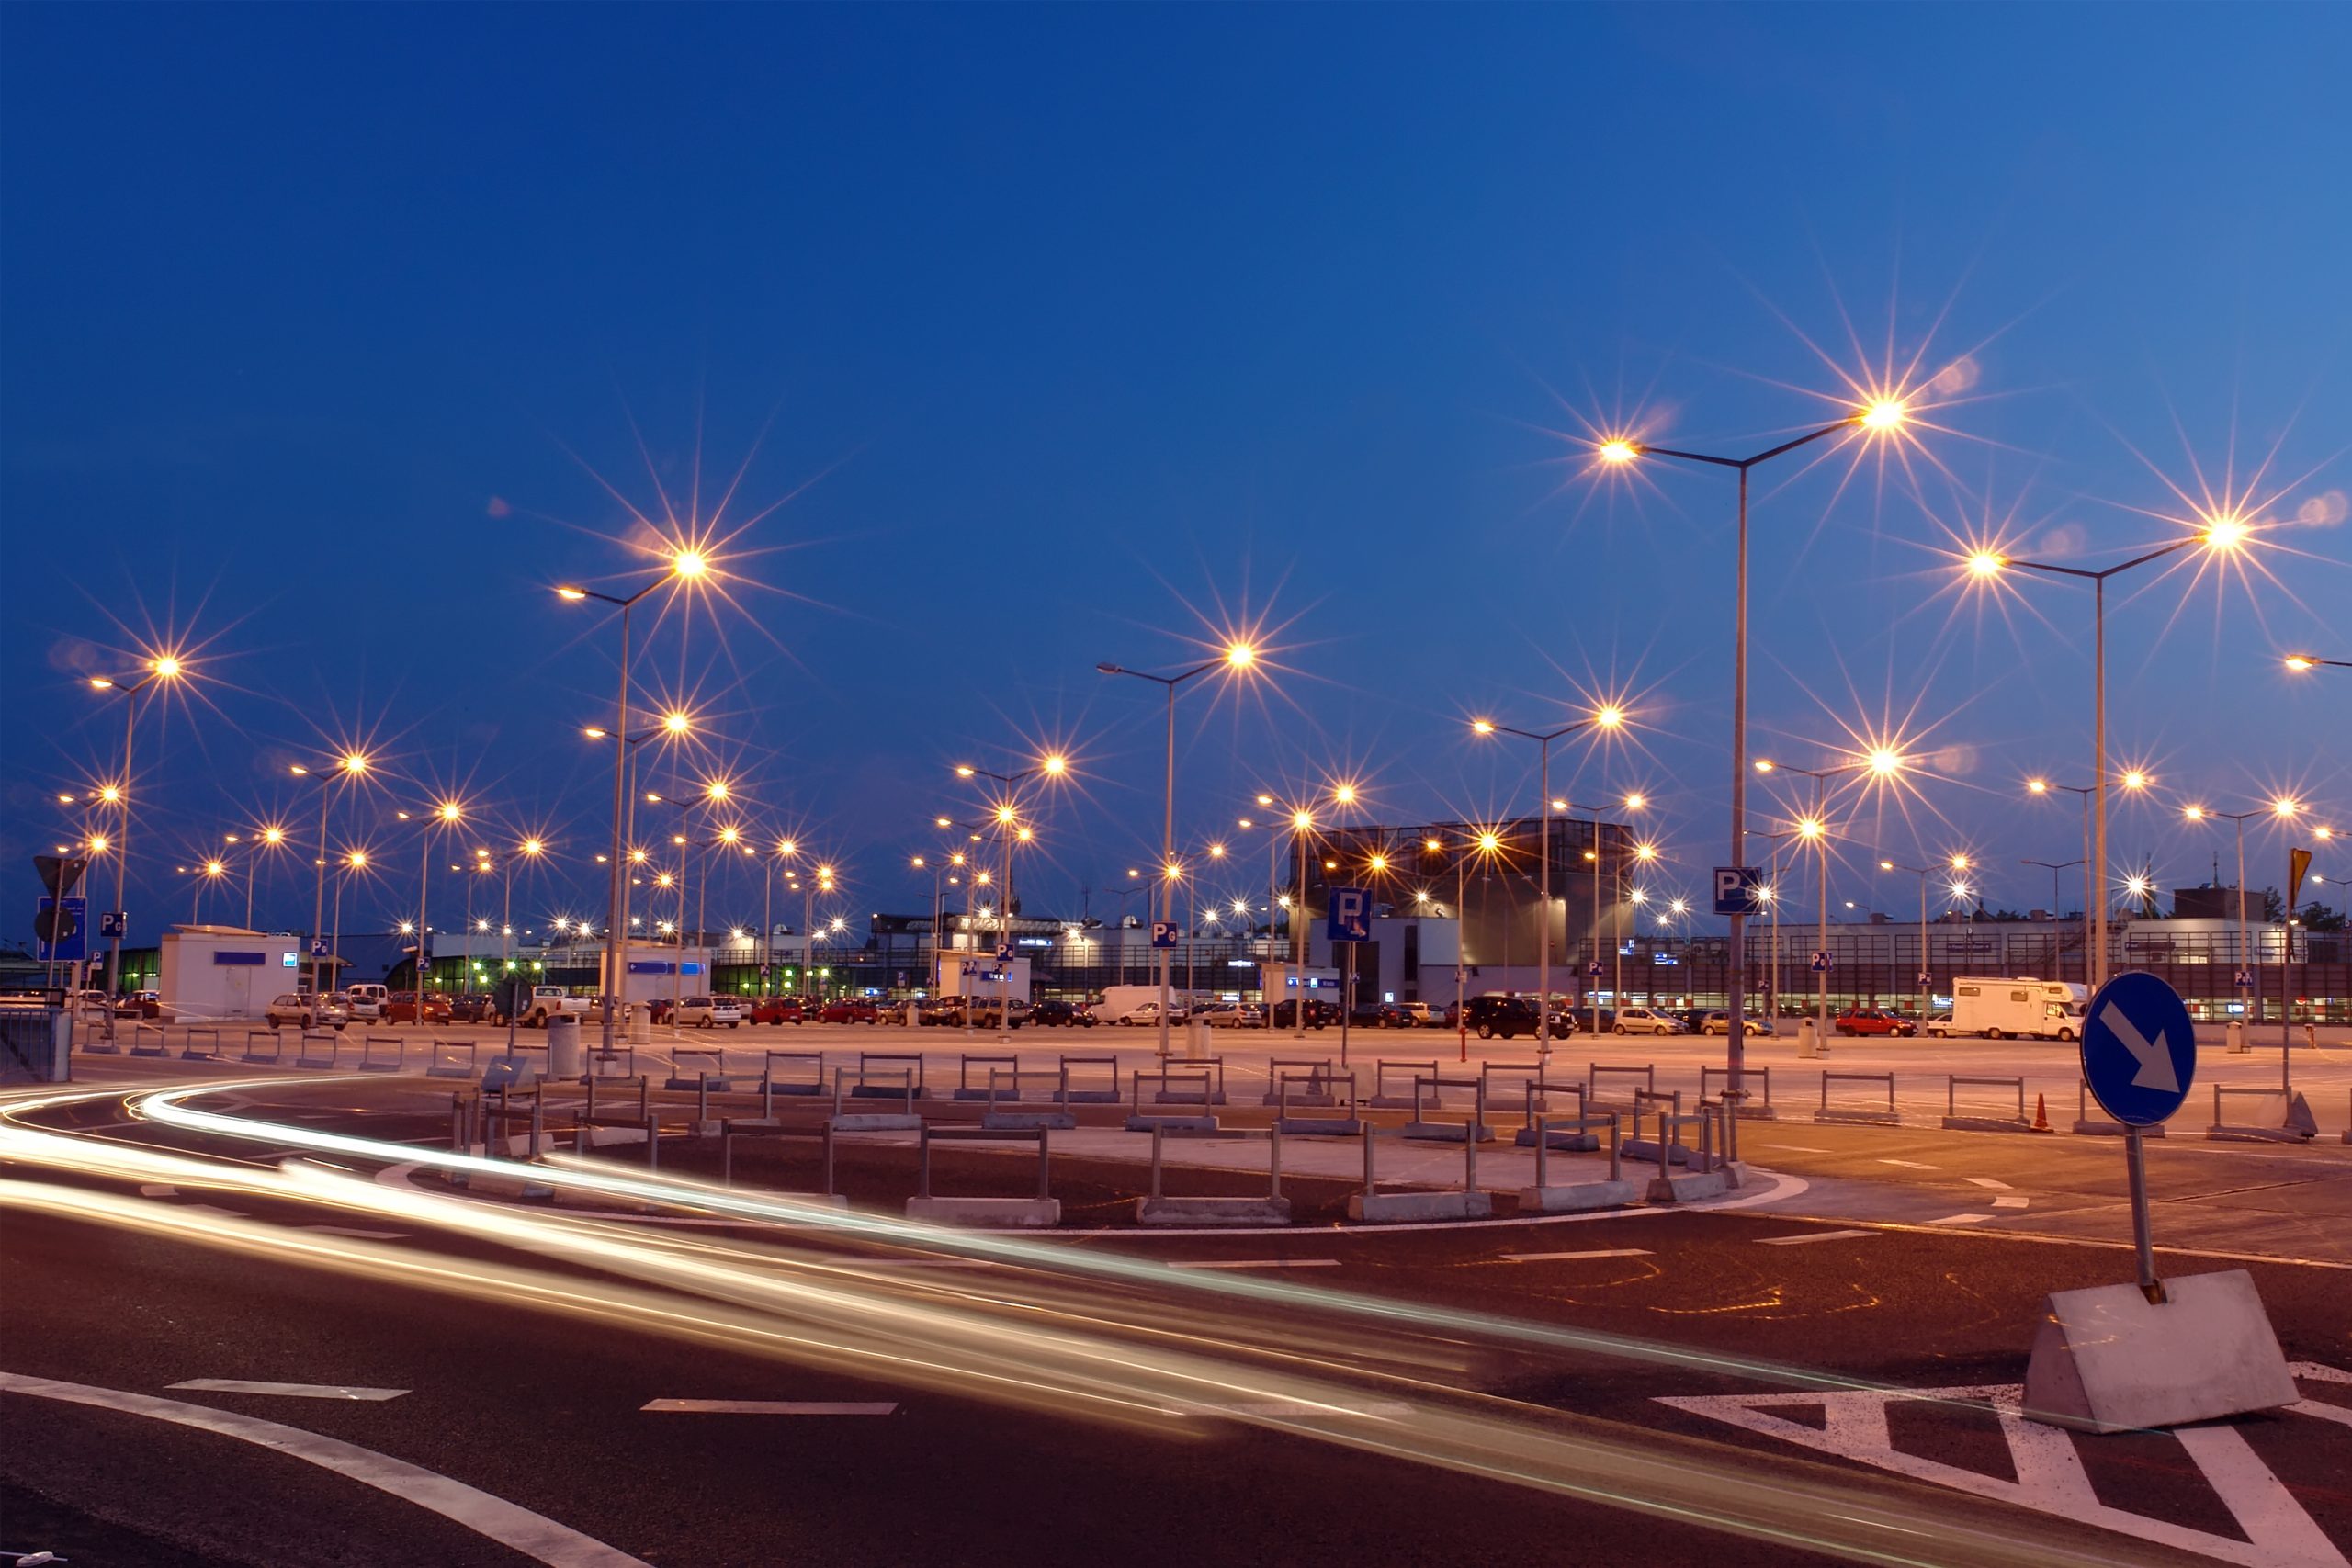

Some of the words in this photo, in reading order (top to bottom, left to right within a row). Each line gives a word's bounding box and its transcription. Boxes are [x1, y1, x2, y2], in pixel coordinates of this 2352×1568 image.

[1717, 871, 1740, 900] P
[1338, 892, 1363, 925] P
[102, 914, 114, 931] P
[115, 922, 121, 931] G
[1153, 923, 1167, 942] P
[1169, 931, 1176, 942] G
[312, 941, 322, 953] P
[997, 944, 1007, 957] P
[93, 952, 101, 961] P
[417, 958, 424, 967] P
[1812, 953, 1820, 966] P
[1589, 962, 1598, 972] P
[1919, 973, 1926, 982] P
[2235, 972, 2242, 982] P
